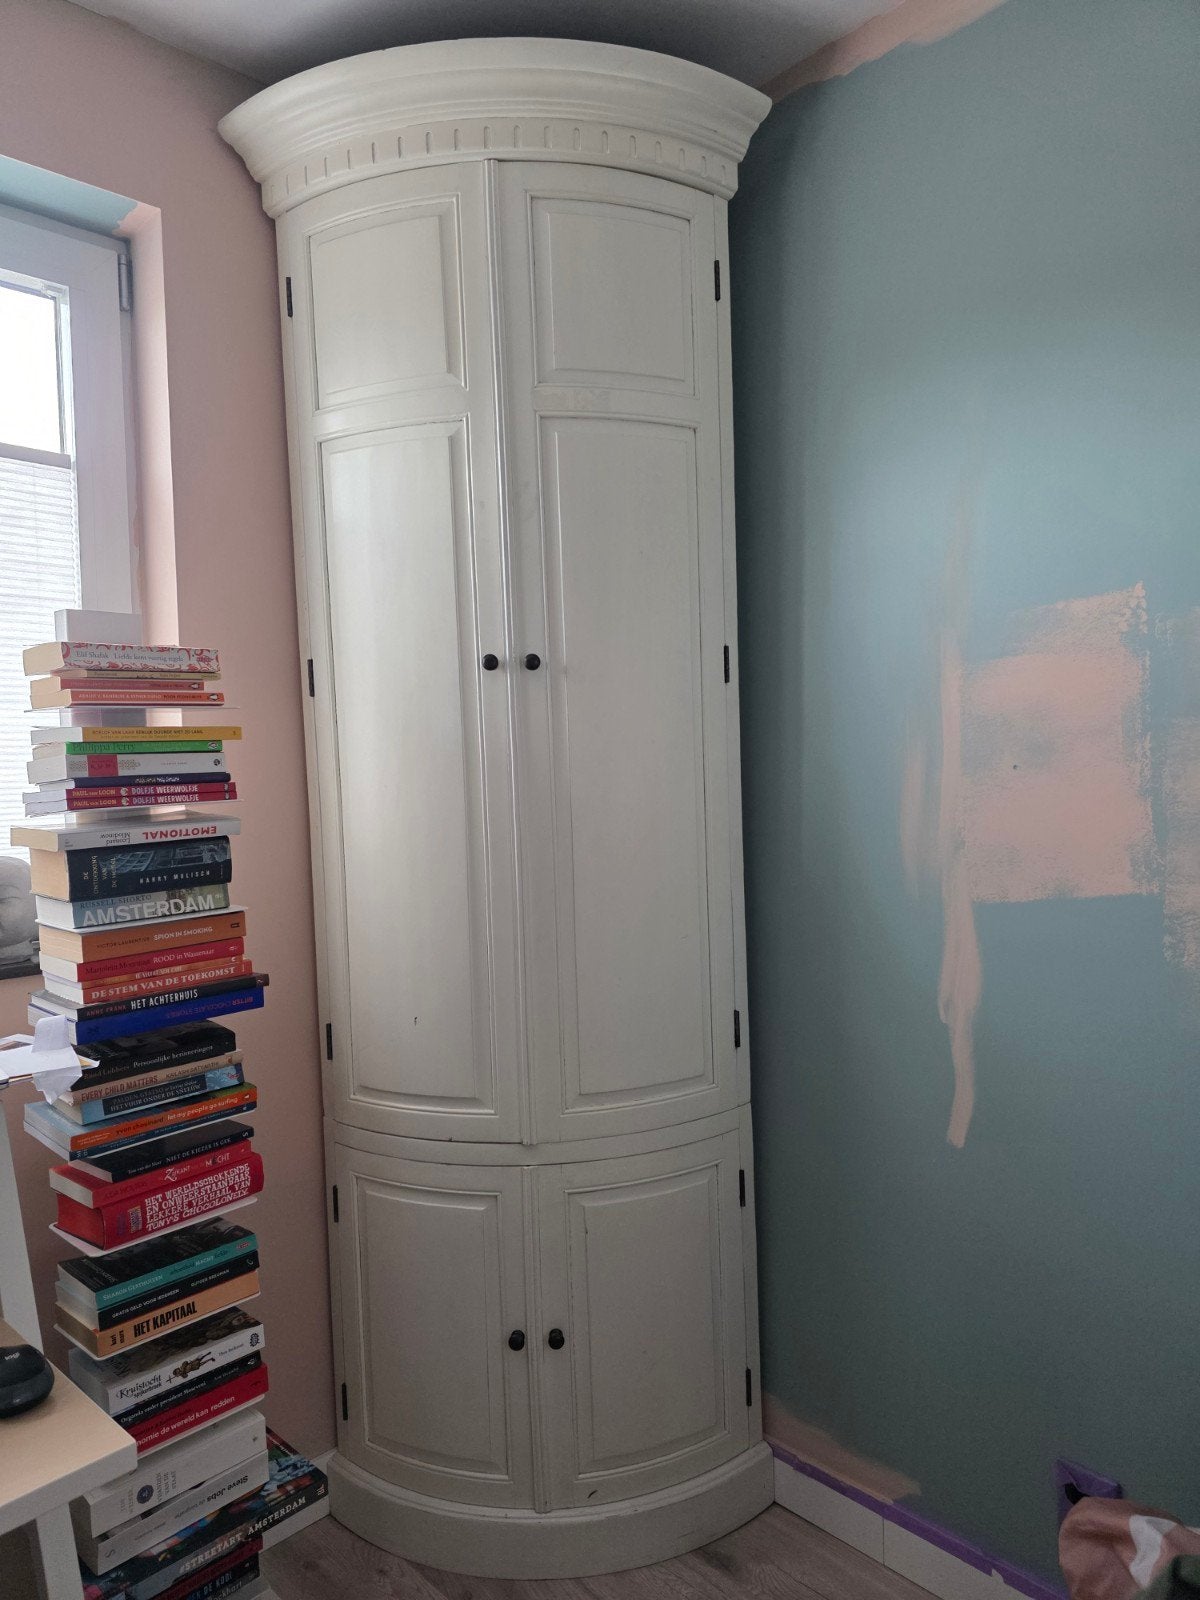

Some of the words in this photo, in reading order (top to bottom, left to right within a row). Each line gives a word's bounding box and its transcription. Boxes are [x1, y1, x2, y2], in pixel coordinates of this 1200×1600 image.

[89, 651, 109, 659] Shafak
[114, 652, 132, 660] Liefde
[72, 742, 110, 752] Philippa
[113, 742, 136, 751] Perry
[132, 787, 155, 795] DOLFJE
[157, 784, 199, 794] WEERWOLFJE
[133, 796, 156, 805] DOLFJE
[158, 794, 200, 803] WEERWOLFJE
[100, 831, 131, 839] Mlodinow
[142, 825, 217, 840] EMOTIONAL
[105, 838, 131, 846] Leonard
[139, 875, 168, 884] HARRY
[173, 869, 210, 880] MULISCH
[80, 899, 115, 910] RUSSELL
[118, 893, 152, 904] SHORTO
[83, 894, 215, 927] AMSTERDAM
[153, 931, 175, 941] SPION
[183, 926, 214, 936] SMOKING
[153, 954, 175, 964] ROOD
[183, 948, 215, 958] Wassenaar
[91, 989, 107, 999] DE
[108, 984, 139, 996] STEM
[140, 979, 164, 990] VAN
[165, 977, 180, 986] DE
[180, 966, 236, 982] TOEKOMST
[86, 1009, 104, 1017] ANNE
[105, 1004, 127, 1013] FRANK
[130, 998, 147, 1010] HET
[149, 989, 199, 1007] ACHTERHUIS
[133, 1054, 171, 1068] Persoonlijke
[81, 1089, 103, 1102] EVERY
[105, 1083, 125, 1096] CHILD
[126, 1075, 158, 1089] MATTERS
[143, 1094, 165, 1103] ONDER
[166, 1090, 175, 1098] DE
[116, 1126, 132, 1135] yvon
[167, 1113, 176, 1121] let
[186, 1104, 209, 1117] people
[208, 1103, 218, 1111] go
[218, 1096, 238, 1107] surfing
[166, 1152, 181, 1162] NIET
[182, 1150, 191, 1158] DE
[191, 1143, 212, 1155] KIEZER
[219, 1137, 232, 1146] GEK
[144, 1193, 163, 1207] HET
[165, 1162, 250, 1200] WERELDSCHOKKENDE
[146, 1203, 159, 1216] EN
[162, 1171, 251, 1210] ONWEERSTAANBAAR
[146, 1202, 189, 1224] LEKKERE
[192, 1187, 232, 1207] VERHAAL
[234, 1179, 251, 1192] VAN
[146, 1214, 180, 1232] TONY'S
[182, 1188, 249, 1218] CHOCOLONELY
[102, 1287, 127, 1301] SHARON
[112, 1308, 130, 1319] GRATIS
[130, 1303, 144, 1312] GELD
[143, 1297, 157, 1307] VOOR
[157, 1288, 180, 1301] IEDEREEN
[134, 1318, 151, 1338] HET
[152, 1301, 198, 1330] KAPITAAL
[116, 1375, 161, 1400] Kruistocht
[144, 1402, 159, 1413] onder
[136, 1430, 160, 1446] nomie
[160, 1426, 170, 1435] de
[170, 1413, 195, 1430] wereld
[195, 1407, 209, 1418] kan
[210, 1395, 236, 1412] redden
[227, 1475, 248, 1491] Steve
[206, 1488, 226, 1502] Jobs
[179, 1532, 243, 1574] #STREETART
[247, 1496, 306, 1536] AMSTERDAM
